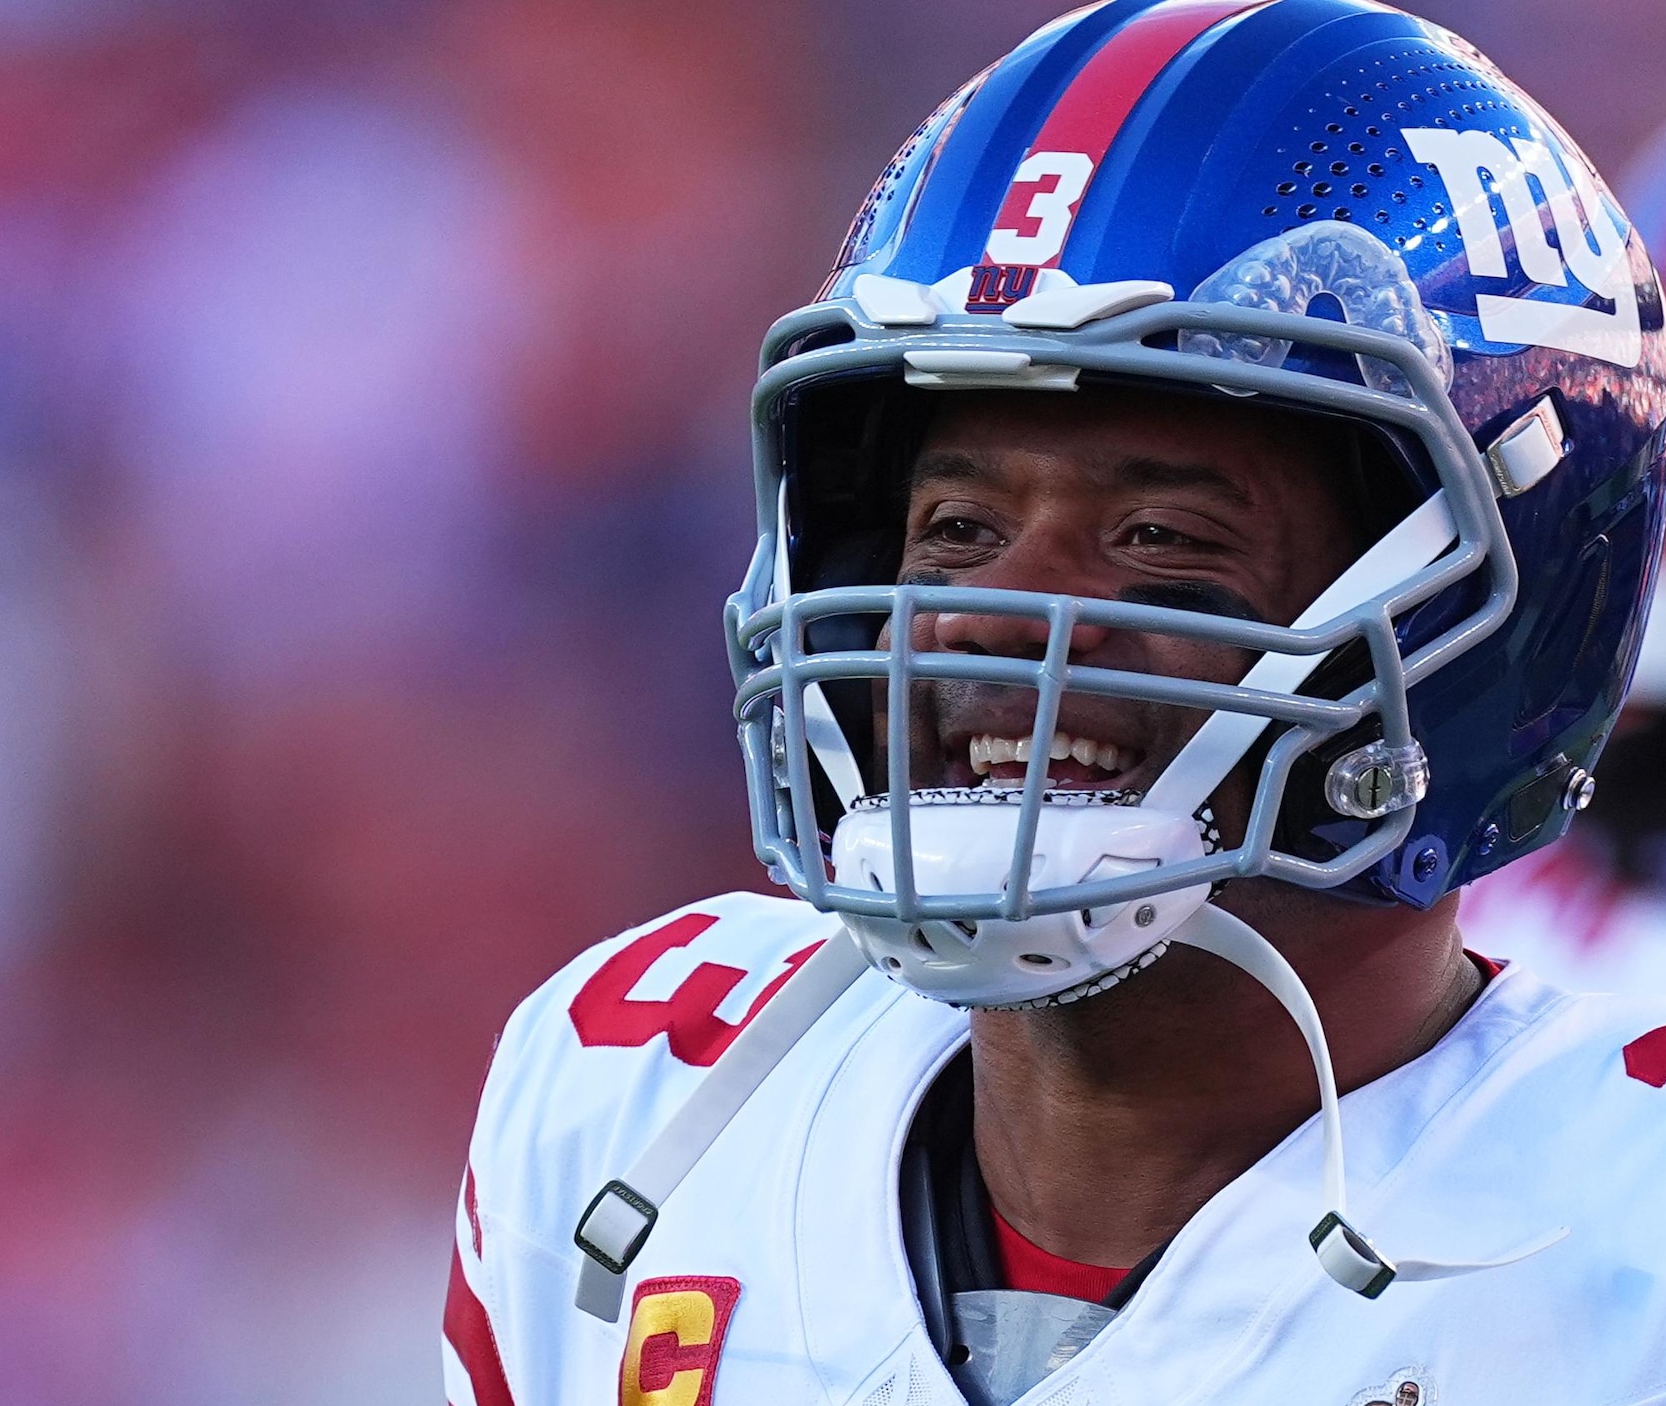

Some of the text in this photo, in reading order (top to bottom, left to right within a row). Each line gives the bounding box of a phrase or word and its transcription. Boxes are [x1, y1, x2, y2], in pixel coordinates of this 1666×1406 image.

[986, 151, 1095, 266] 3
[1399, 127, 1641, 368] ny
[568, 913, 828, 1067] 3
